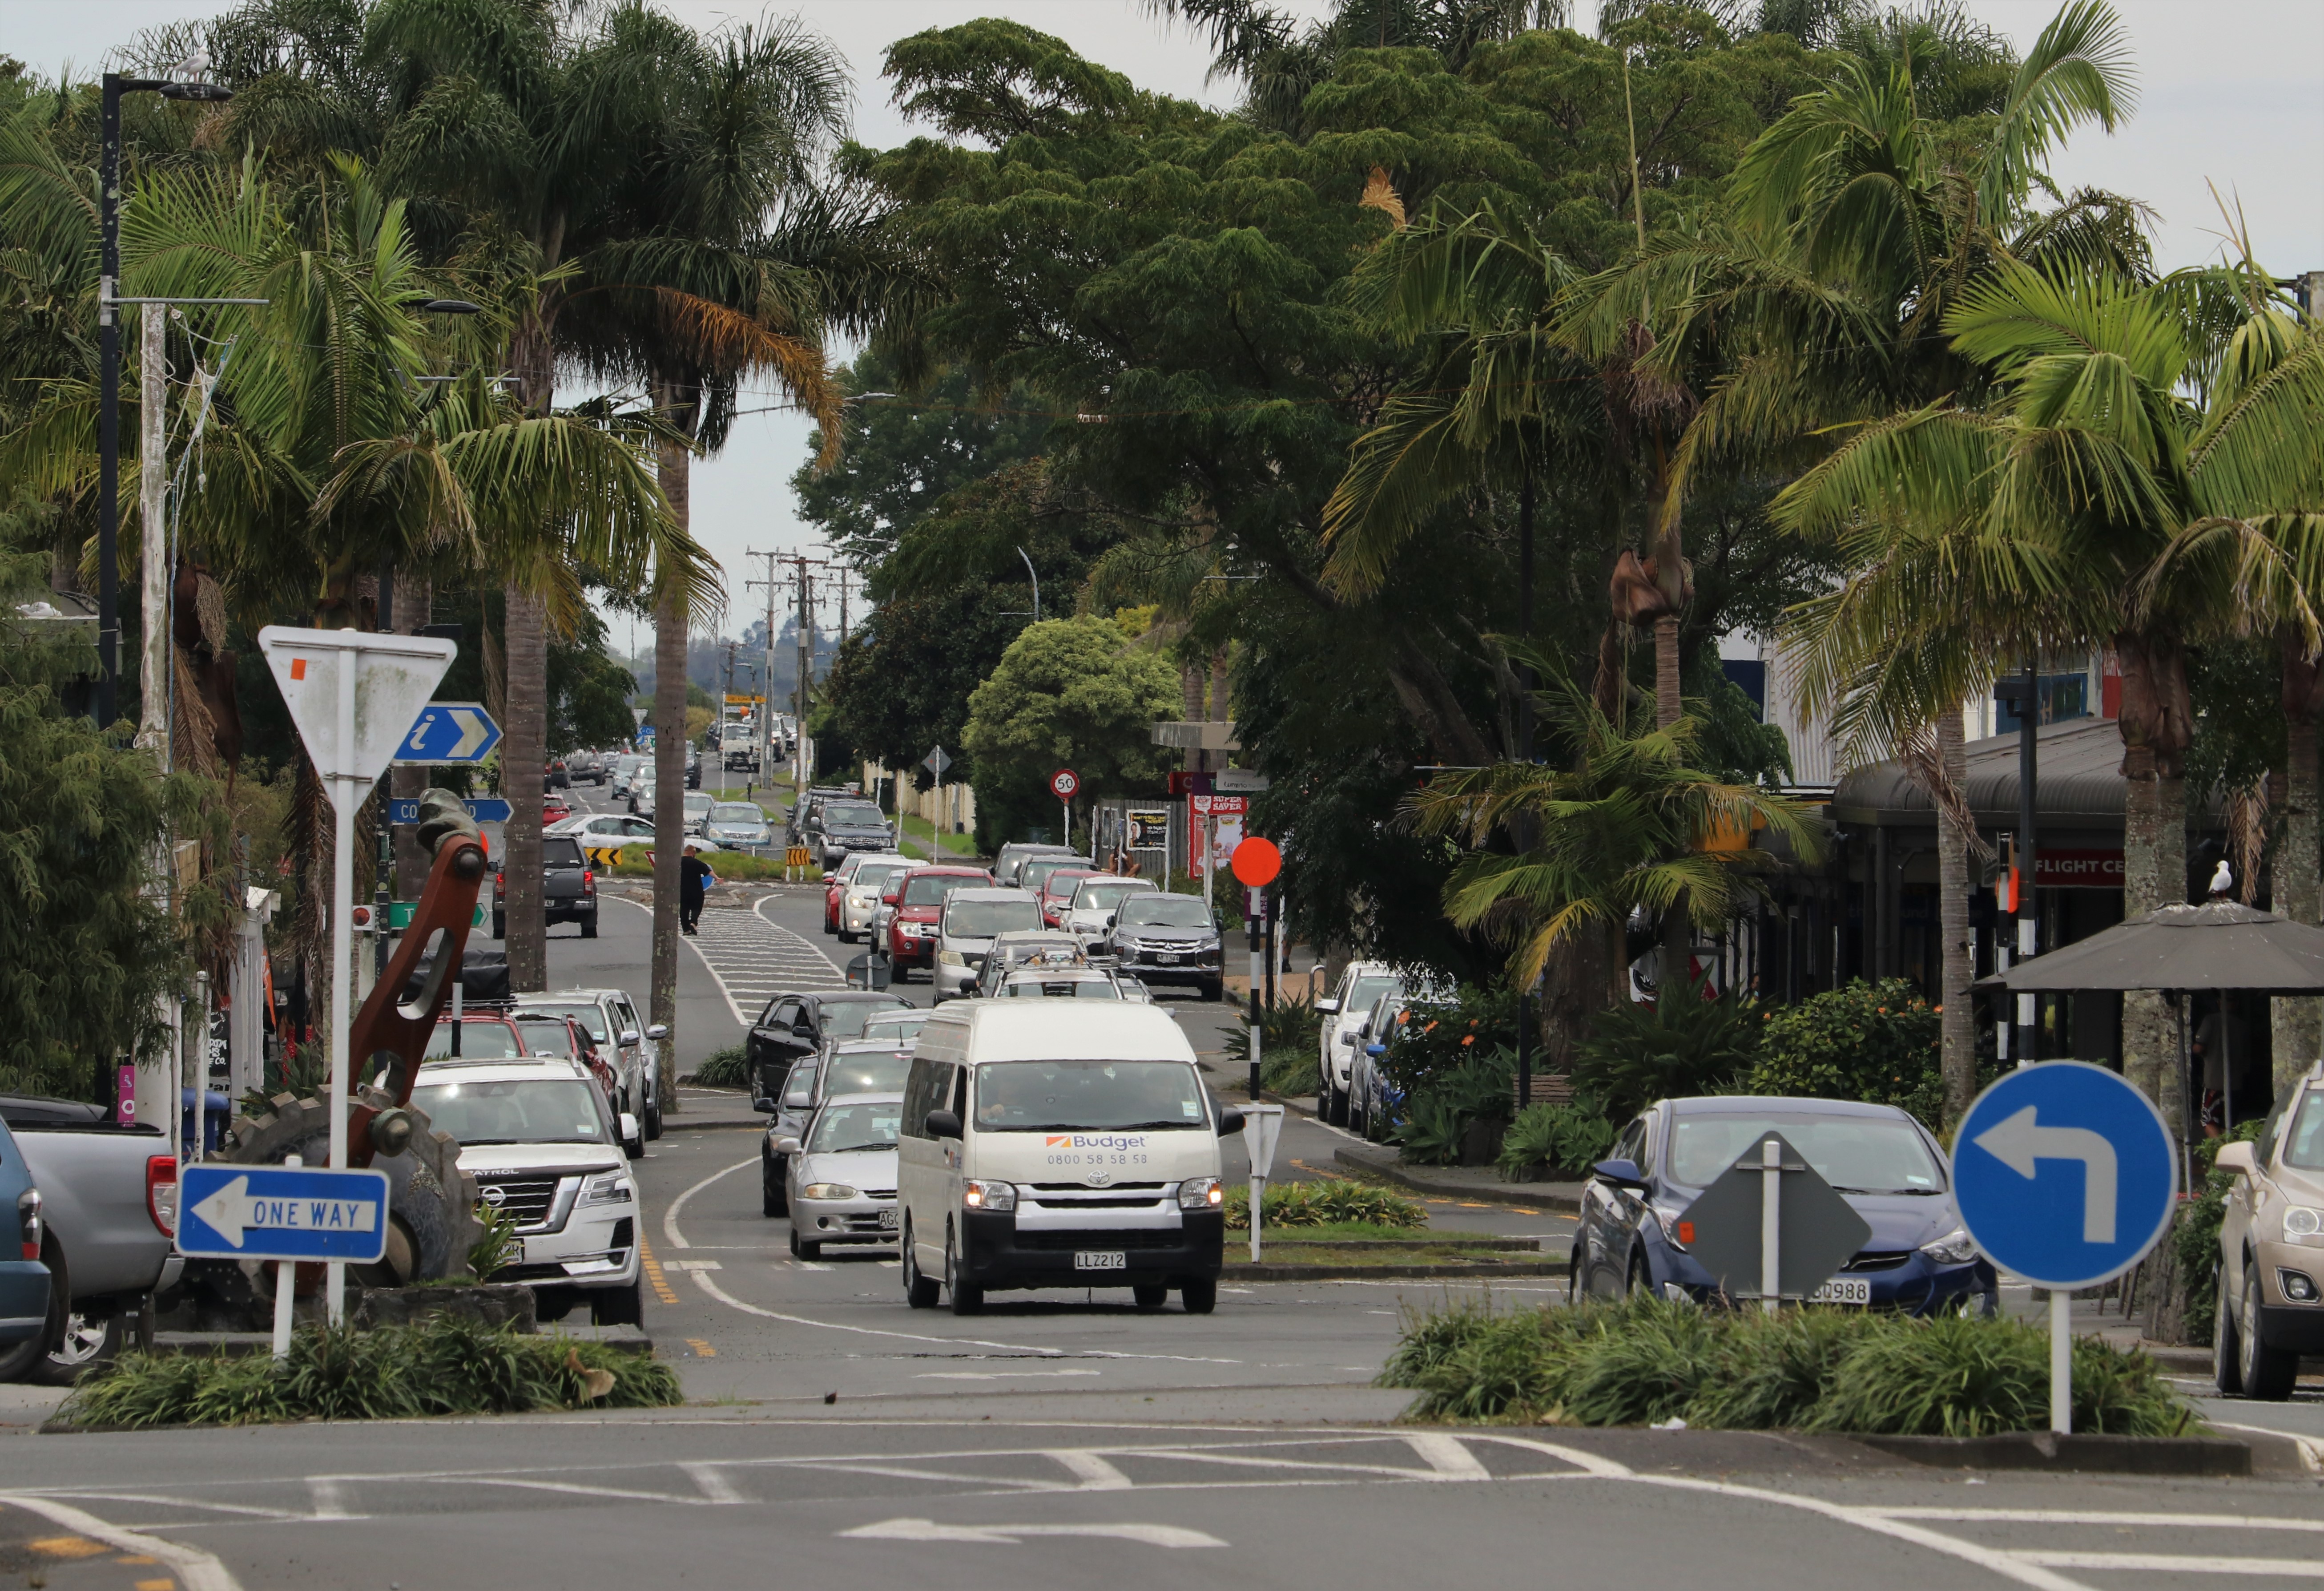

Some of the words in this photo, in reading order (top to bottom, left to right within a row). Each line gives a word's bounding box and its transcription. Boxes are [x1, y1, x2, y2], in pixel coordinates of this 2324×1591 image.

[1058, 778, 1073, 789] 50
[401, 804, 417, 819] CO
[1213, 803, 1242, 811] SAVER
[2035, 859, 2099, 873] FLIGHT
[2102, 860, 2125, 873] CE
[404, 908, 415, 923] T
[215, 1057, 226, 1065] CO.
[1073, 1136, 1146, 1151] Budget
[1047, 1155, 1080, 1165] 0800
[1087, 1154, 1104, 1164] 58
[1110, 1155, 1126, 1165] 58
[1133, 1154, 1147, 1164] 58
[254, 1201, 298, 1226] ONE
[311, 1202, 358, 1228] WAY
[1077, 1254, 1124, 1267] LLZ212
